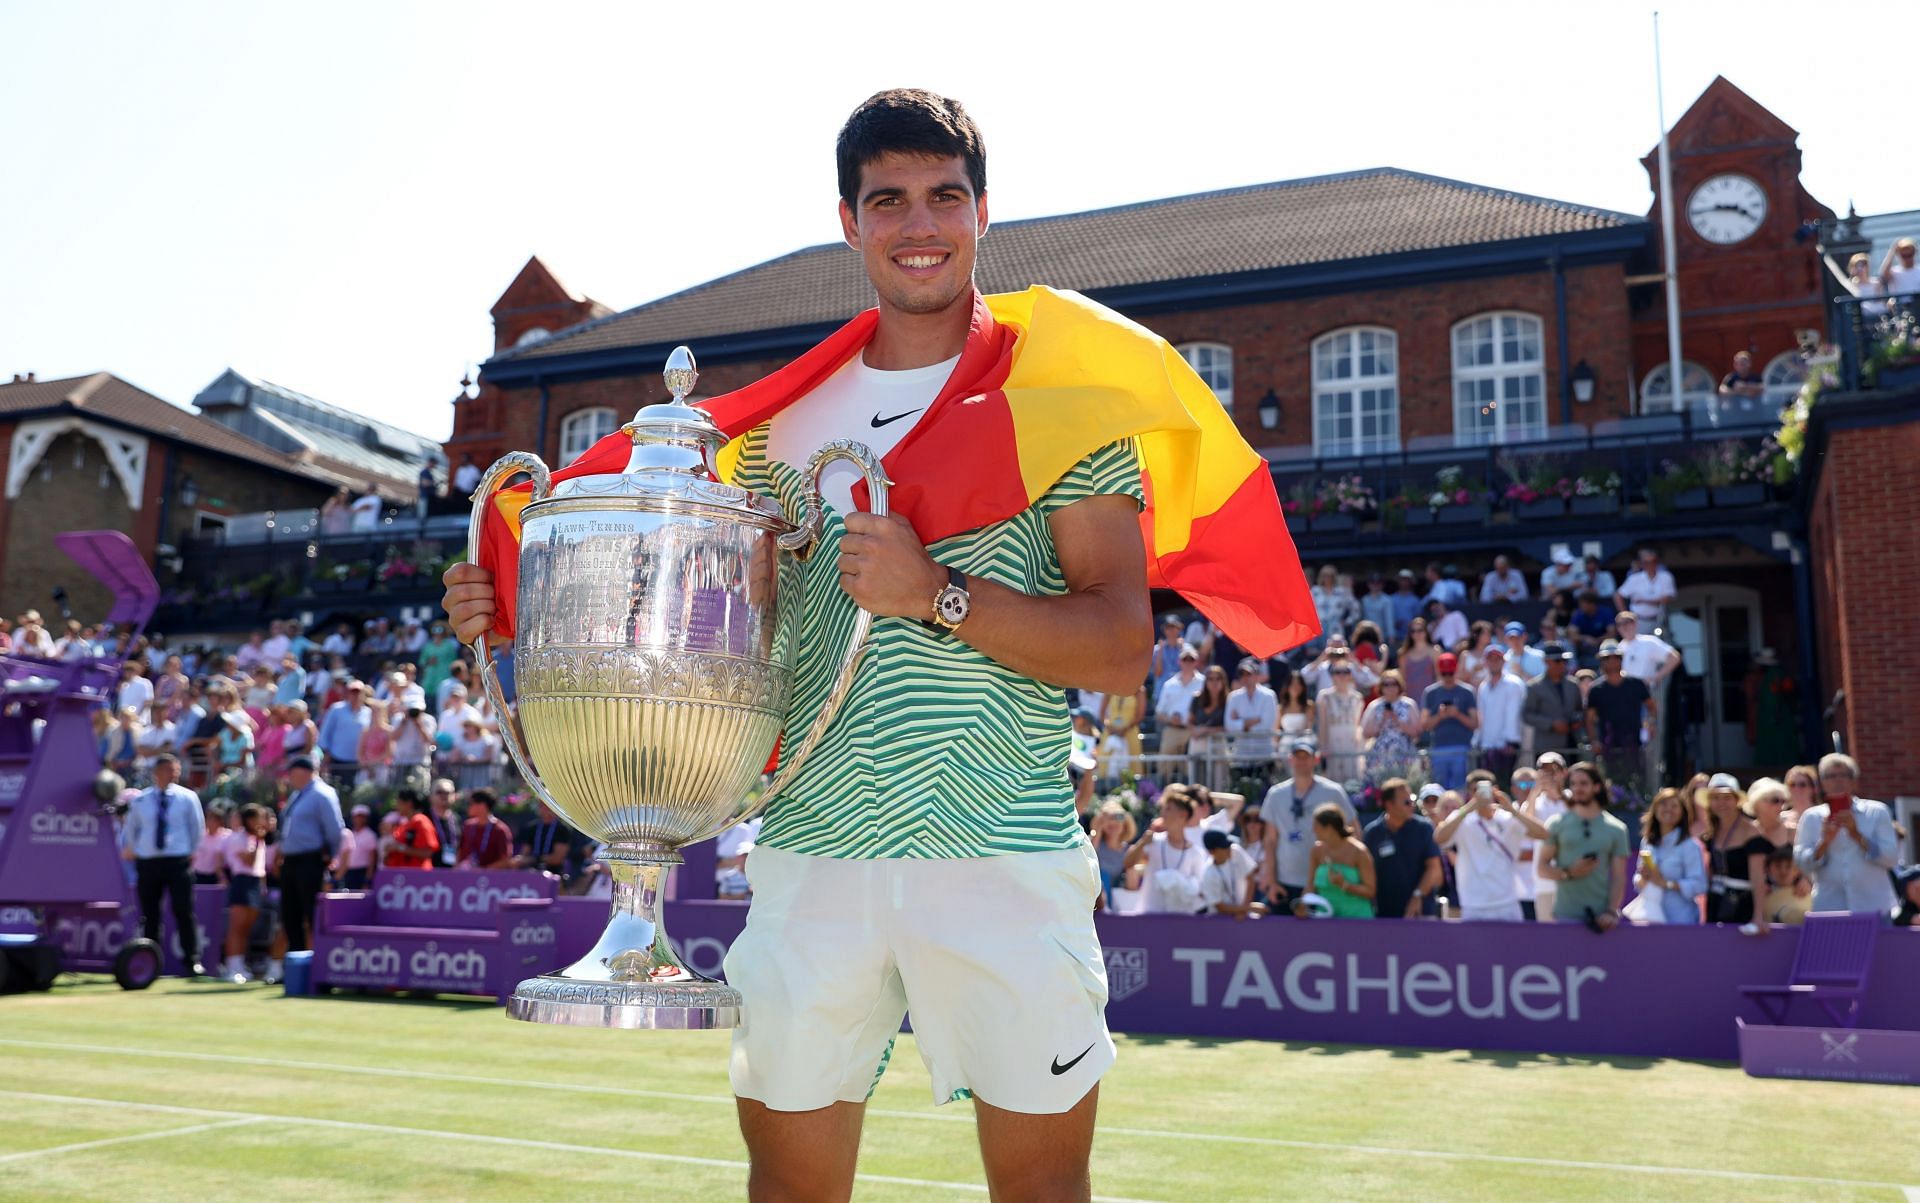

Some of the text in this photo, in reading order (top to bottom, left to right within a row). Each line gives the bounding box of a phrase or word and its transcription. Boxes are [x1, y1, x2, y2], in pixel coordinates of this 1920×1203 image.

[31, 805, 98, 834] cinch
[377, 874, 453, 911] cinch
[328, 937, 487, 979] cinch cinch
